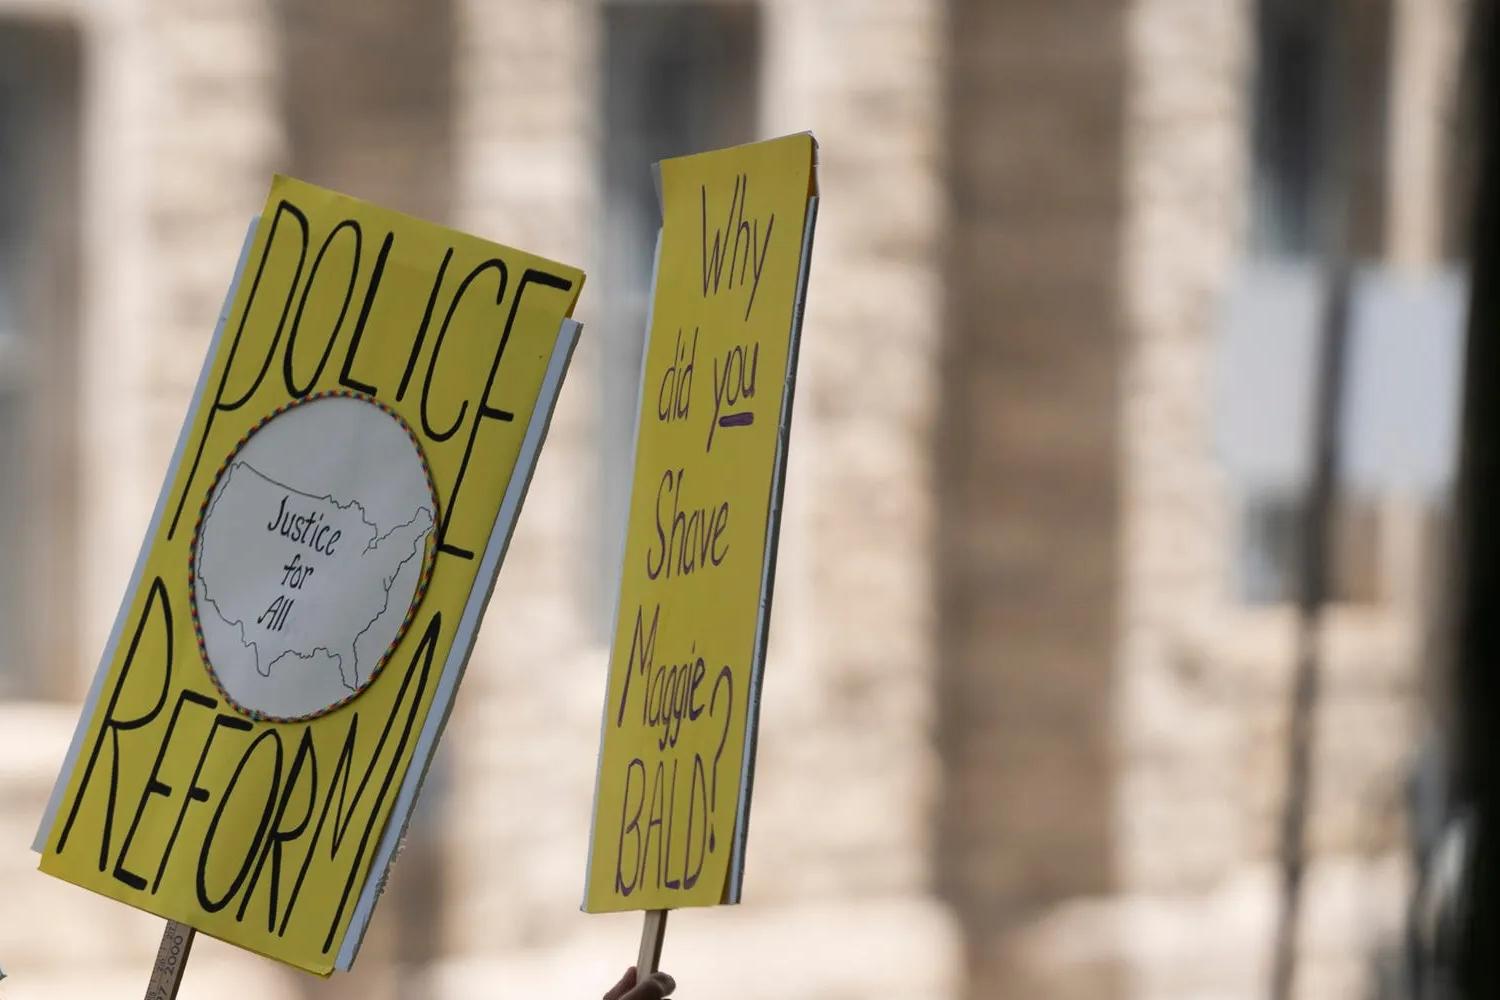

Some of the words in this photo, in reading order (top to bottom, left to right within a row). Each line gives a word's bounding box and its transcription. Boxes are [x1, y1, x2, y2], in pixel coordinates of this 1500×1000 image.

[701, 172, 775, 322] Why
[167, 200, 573, 560] POLICE
[657, 326, 699, 423] did
[706, 341, 759, 453] you
[267, 495, 342, 557] Justice
[282, 553, 315, 591] for
[647, 468, 730, 580] Shave
[257, 596, 294, 633] All
[617, 603, 706, 751] Maggie
[55, 576, 442, 954] REFORM
[164, 935, 183, 975] 2000
